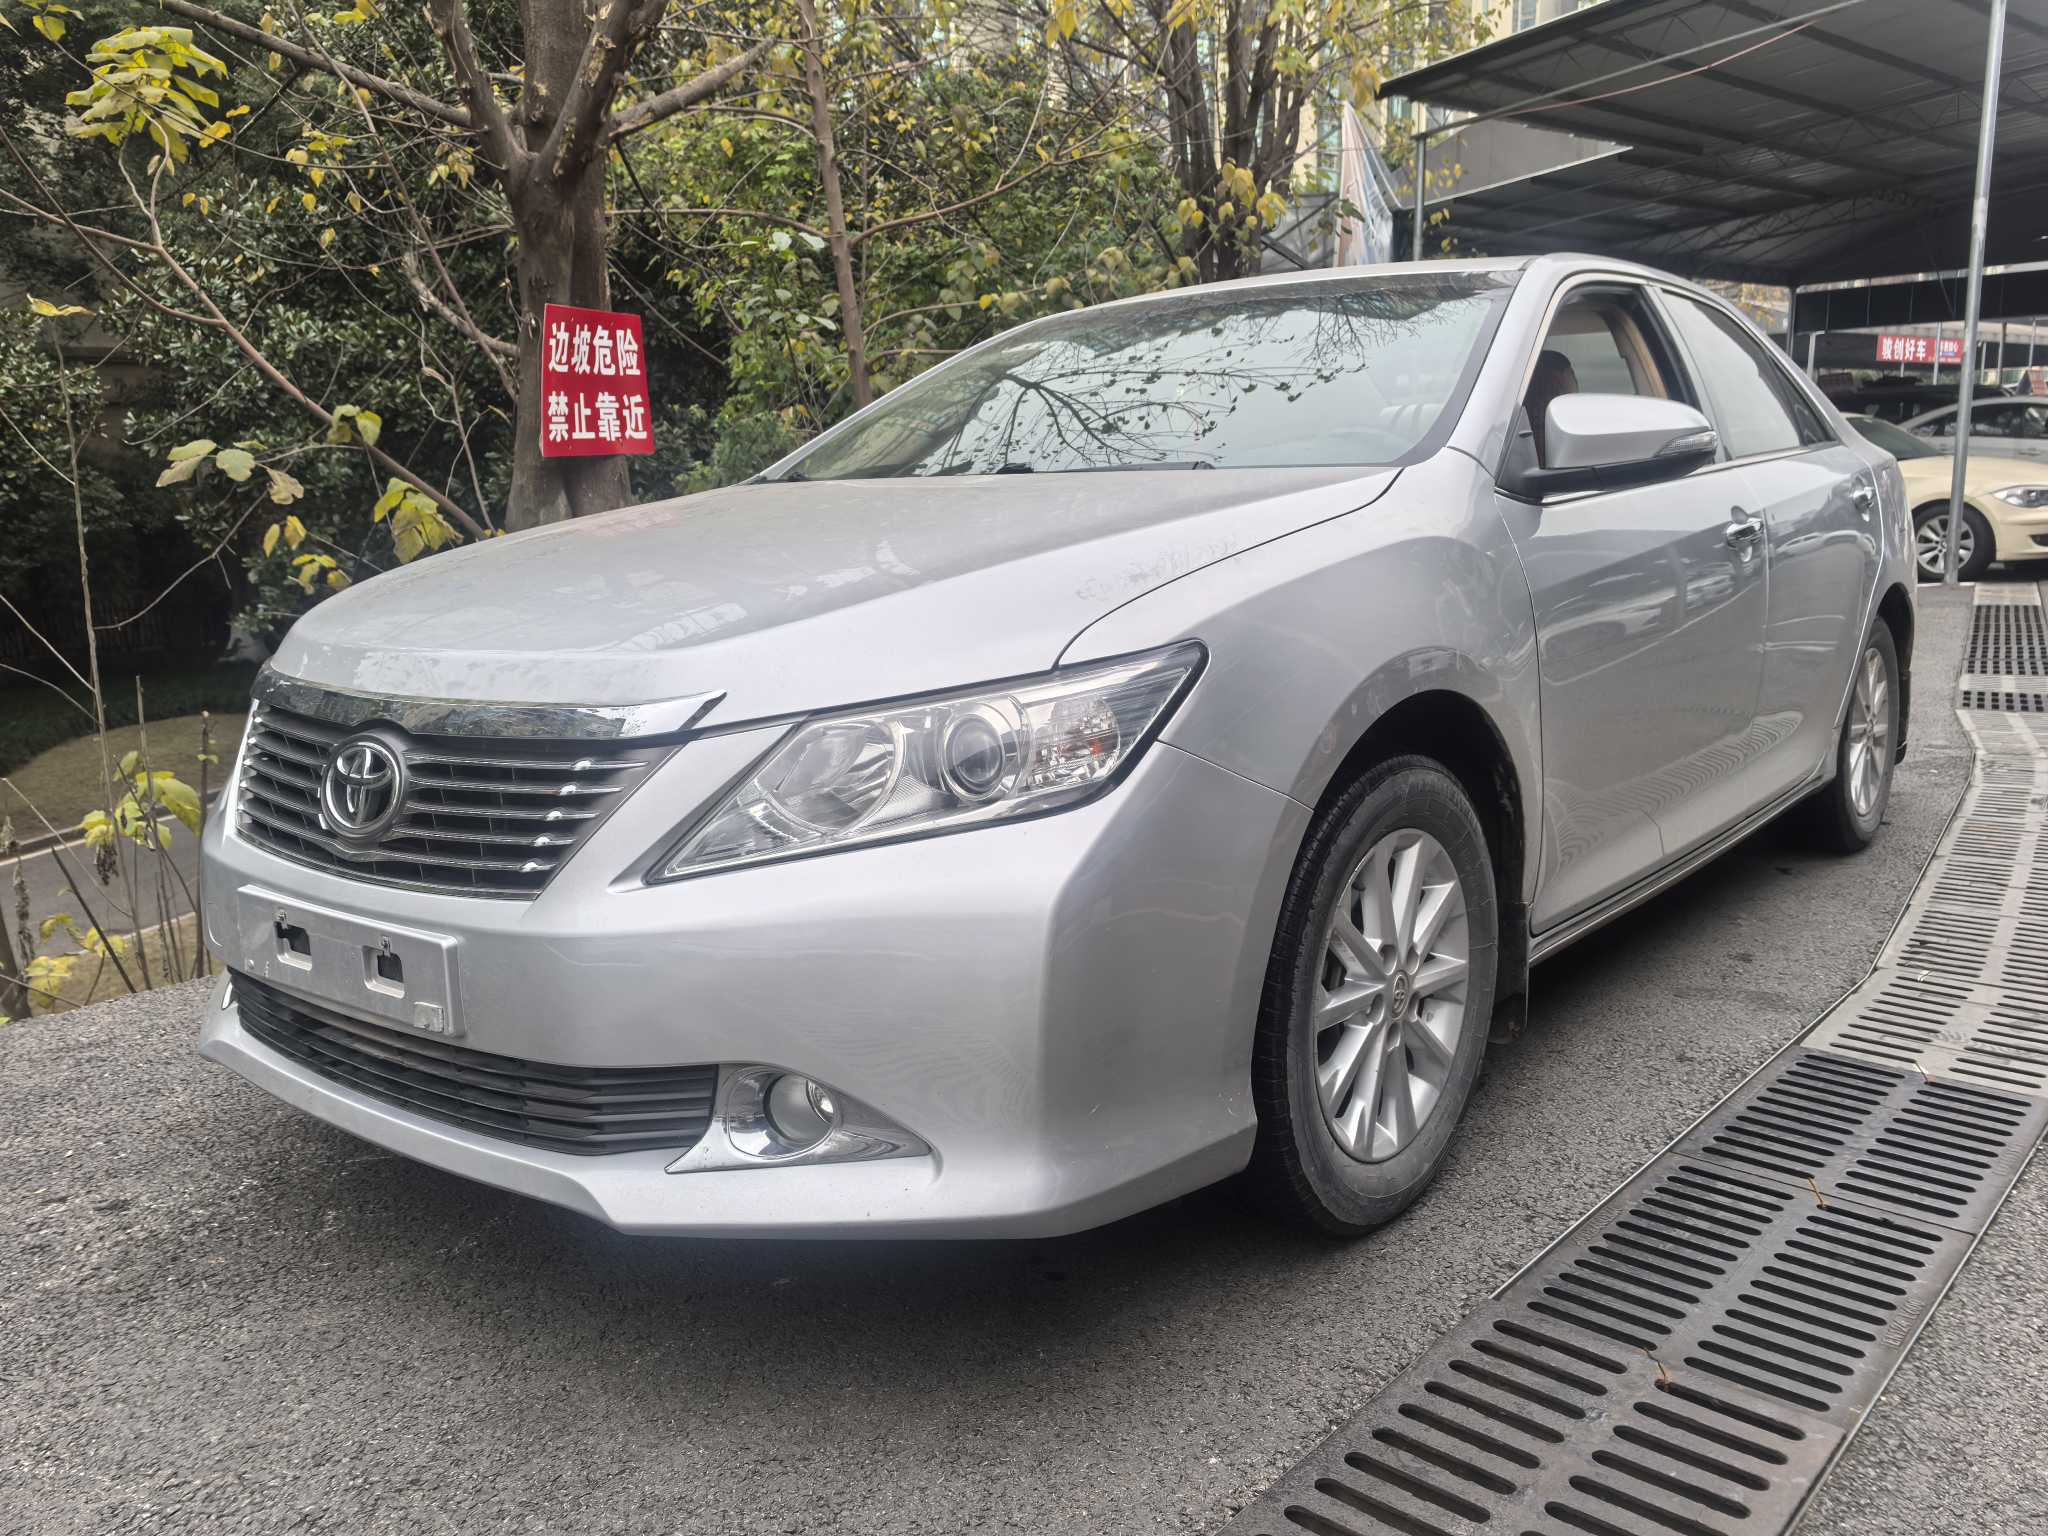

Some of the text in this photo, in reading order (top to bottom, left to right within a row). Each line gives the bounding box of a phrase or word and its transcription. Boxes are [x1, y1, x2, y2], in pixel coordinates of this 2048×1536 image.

[549, 322, 640, 376] 边坡危险
[548, 390, 647, 442] 禁止靠近
